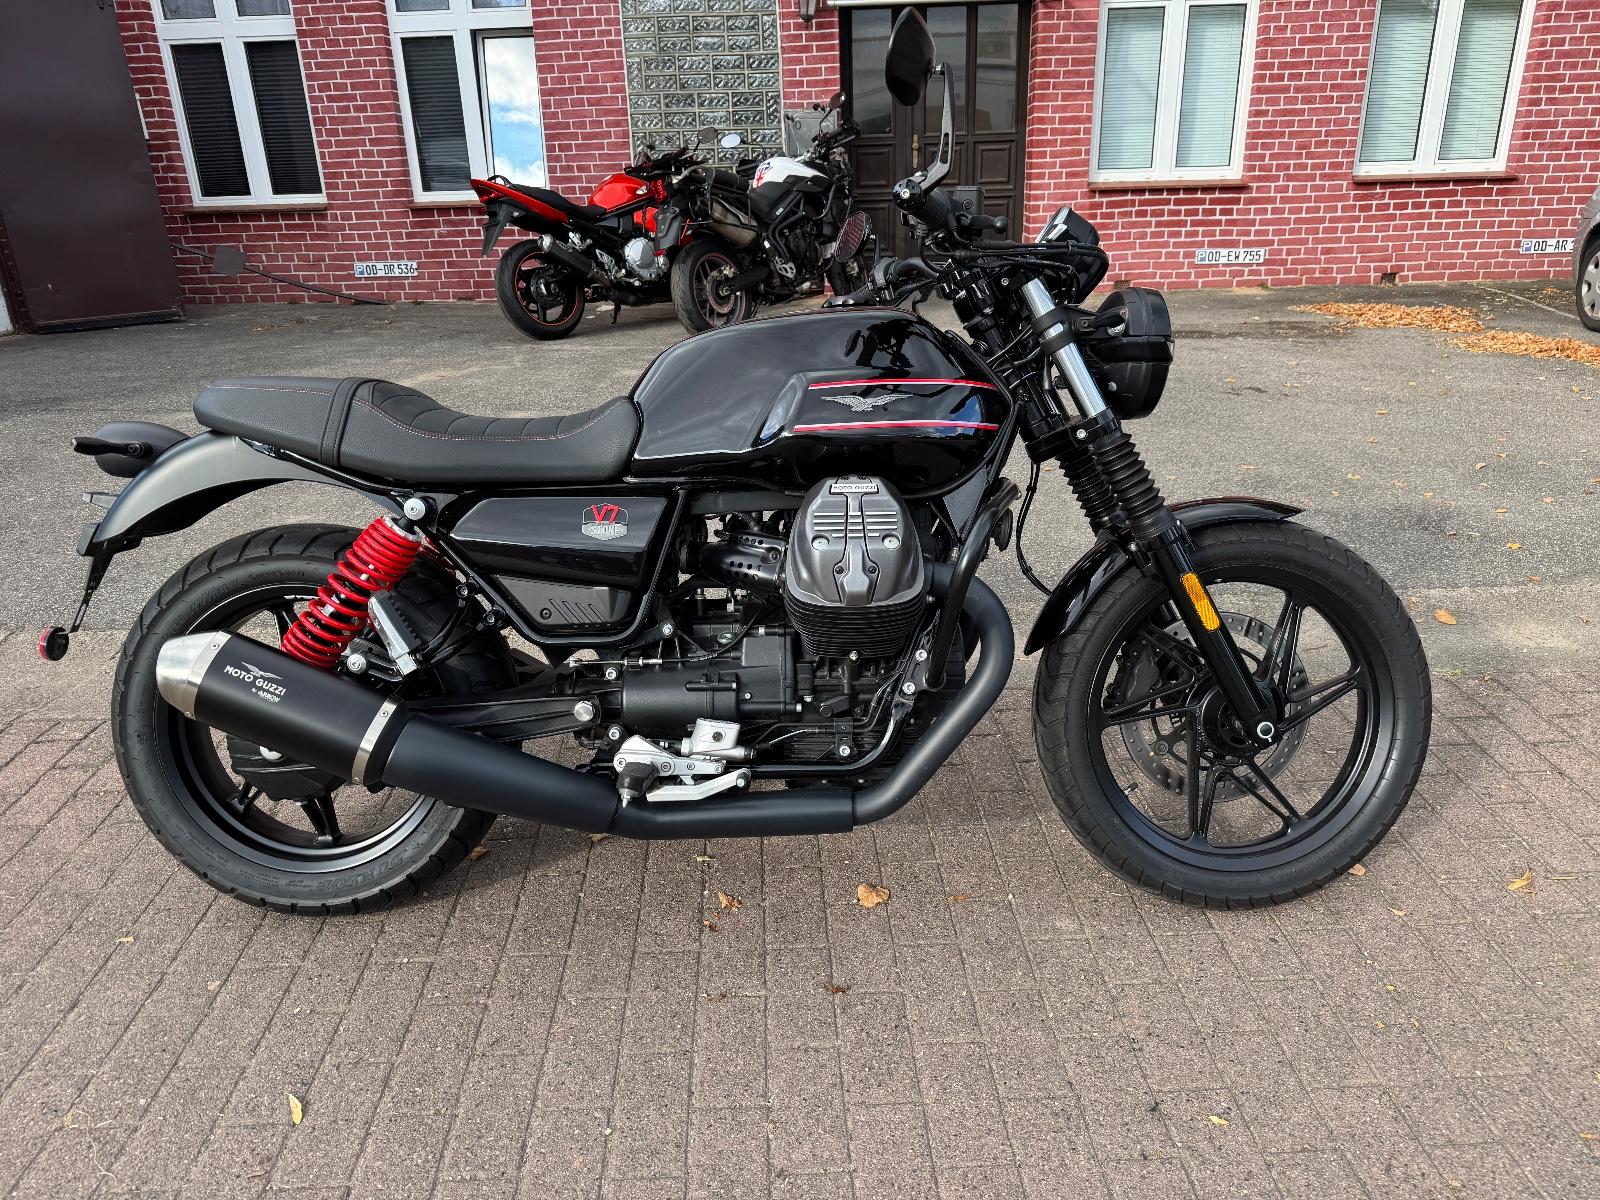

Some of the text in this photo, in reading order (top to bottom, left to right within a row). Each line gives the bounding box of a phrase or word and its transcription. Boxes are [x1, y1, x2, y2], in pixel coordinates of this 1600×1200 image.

[1533, 240, 1568, 252] OD-AR
[1207, 250, 1241, 262] OD-EW
[1242, 250, 1261, 262] 755
[355, 263, 415, 276] P OD-DR 536
[591, 504, 619, 524] V7
[223, 665, 287, 696] MOTO GUZZI
